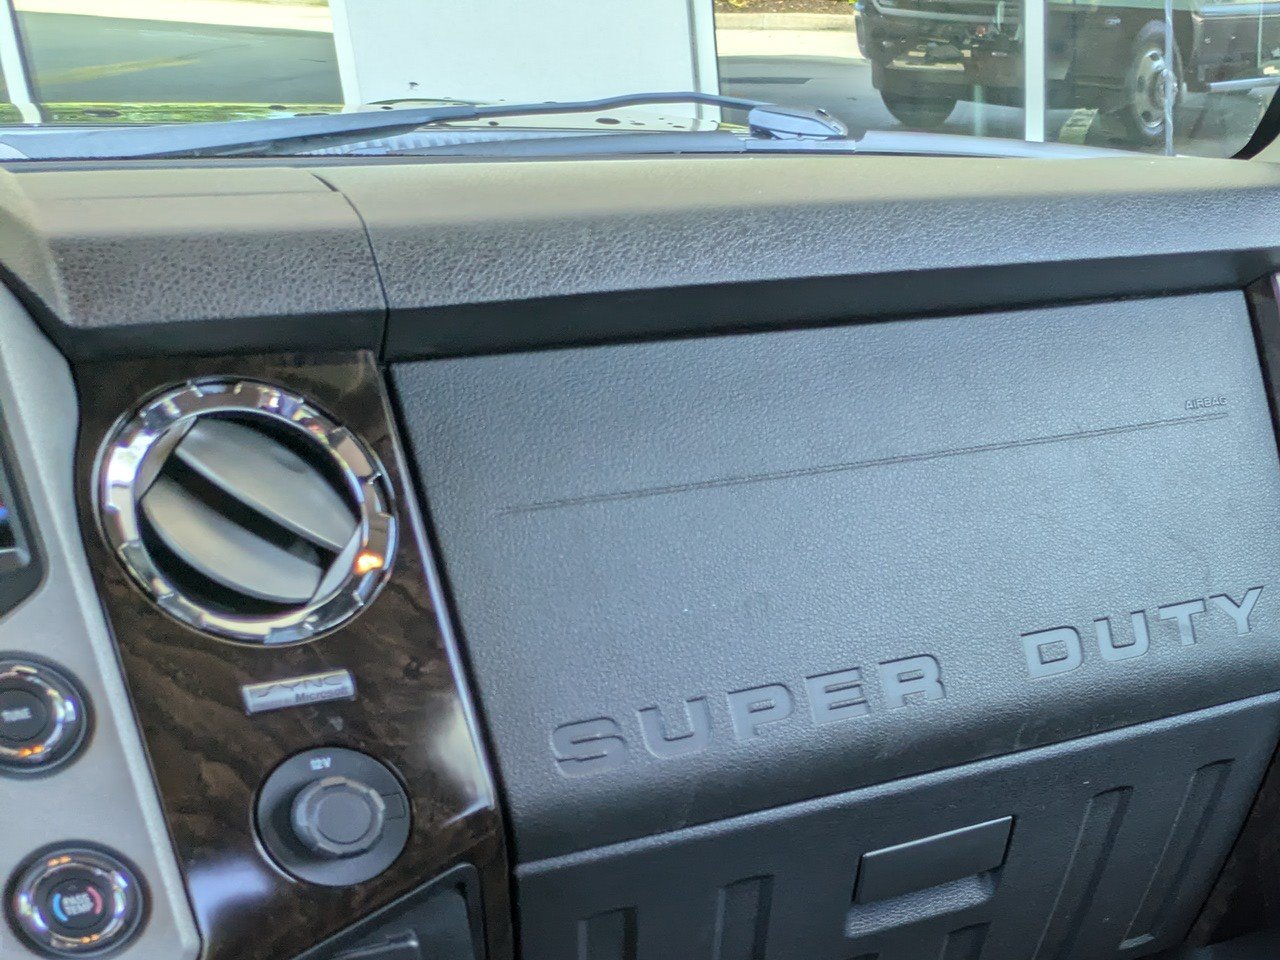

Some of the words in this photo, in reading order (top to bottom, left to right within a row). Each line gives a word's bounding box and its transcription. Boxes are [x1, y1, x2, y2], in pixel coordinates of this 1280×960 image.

[1185, 395, 1229, 410] AIRBAG
[550, 653, 947, 778] SUPER
[1020, 585, 1265, 681] DUTY
